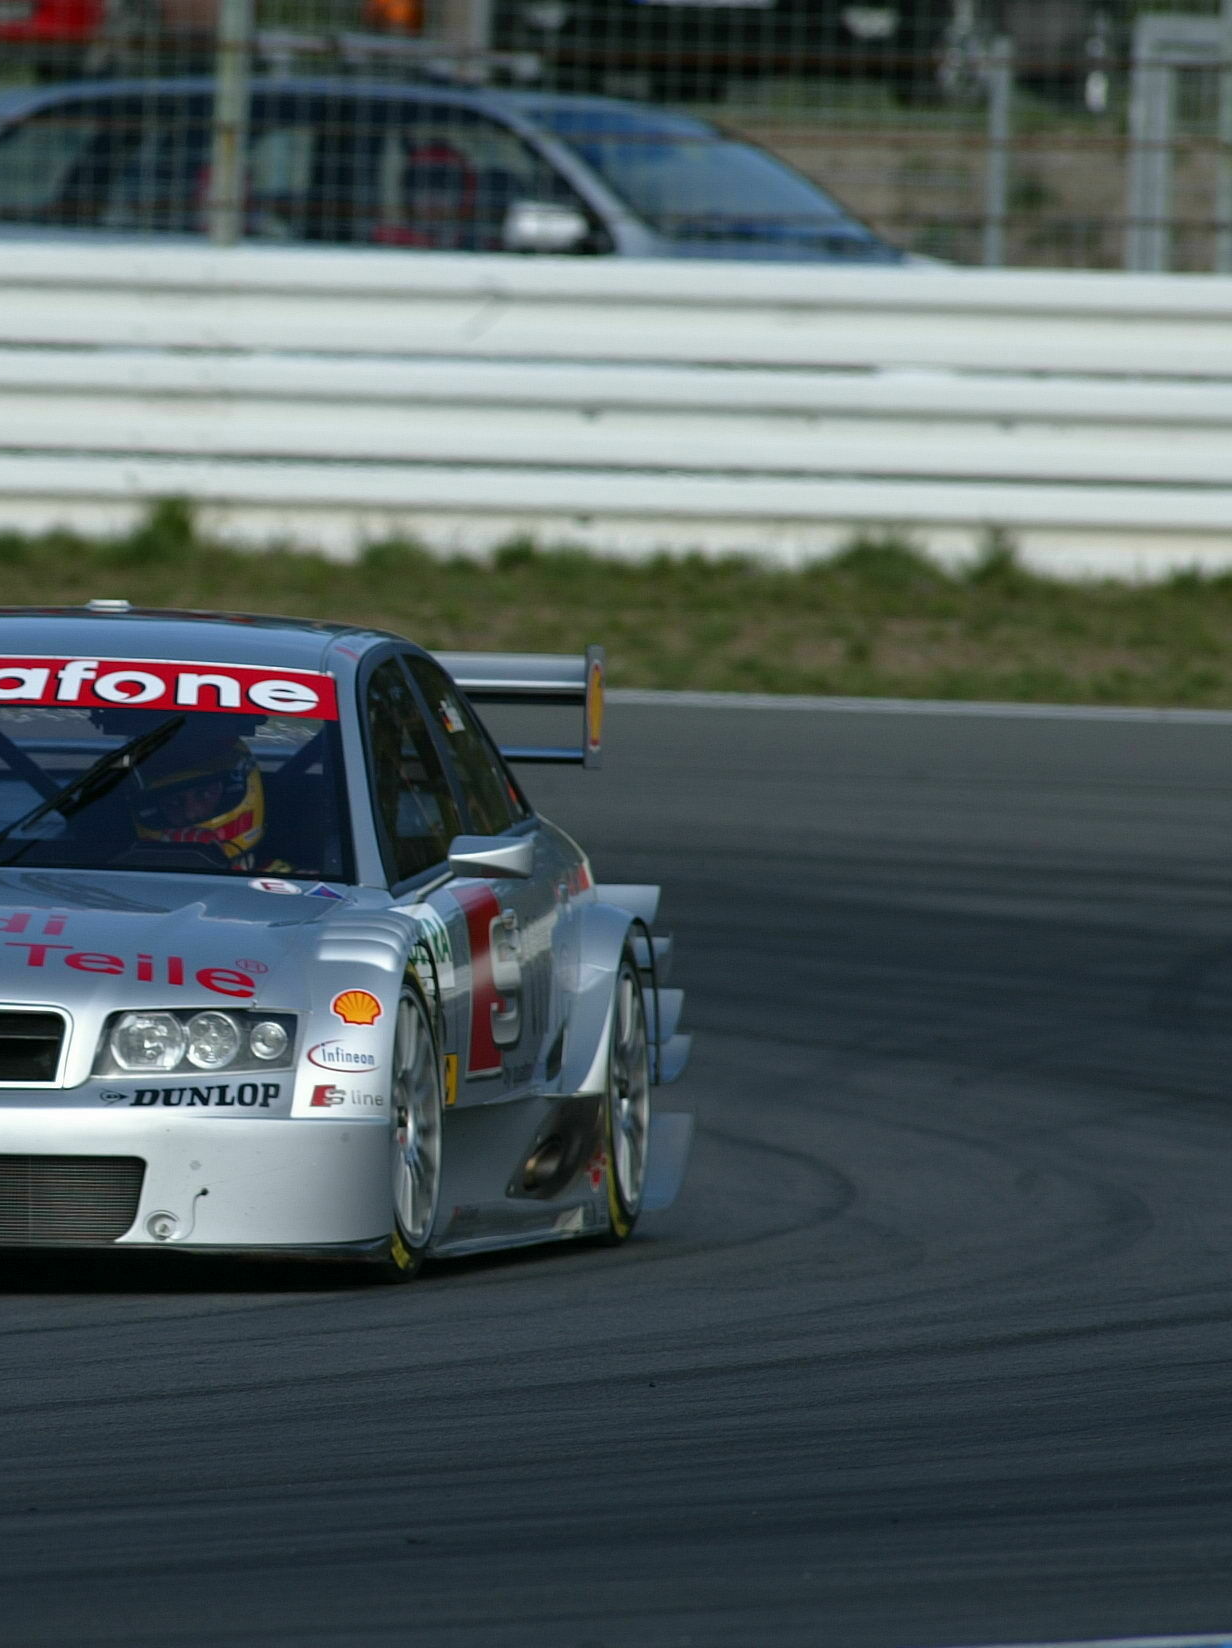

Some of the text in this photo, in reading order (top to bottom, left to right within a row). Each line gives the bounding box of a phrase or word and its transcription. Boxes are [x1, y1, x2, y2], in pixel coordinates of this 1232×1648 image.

[320, 1042, 376, 1066] Infineon
[130, 1082, 281, 1108] DUNLOP
[350, 1089, 385, 1107] line
